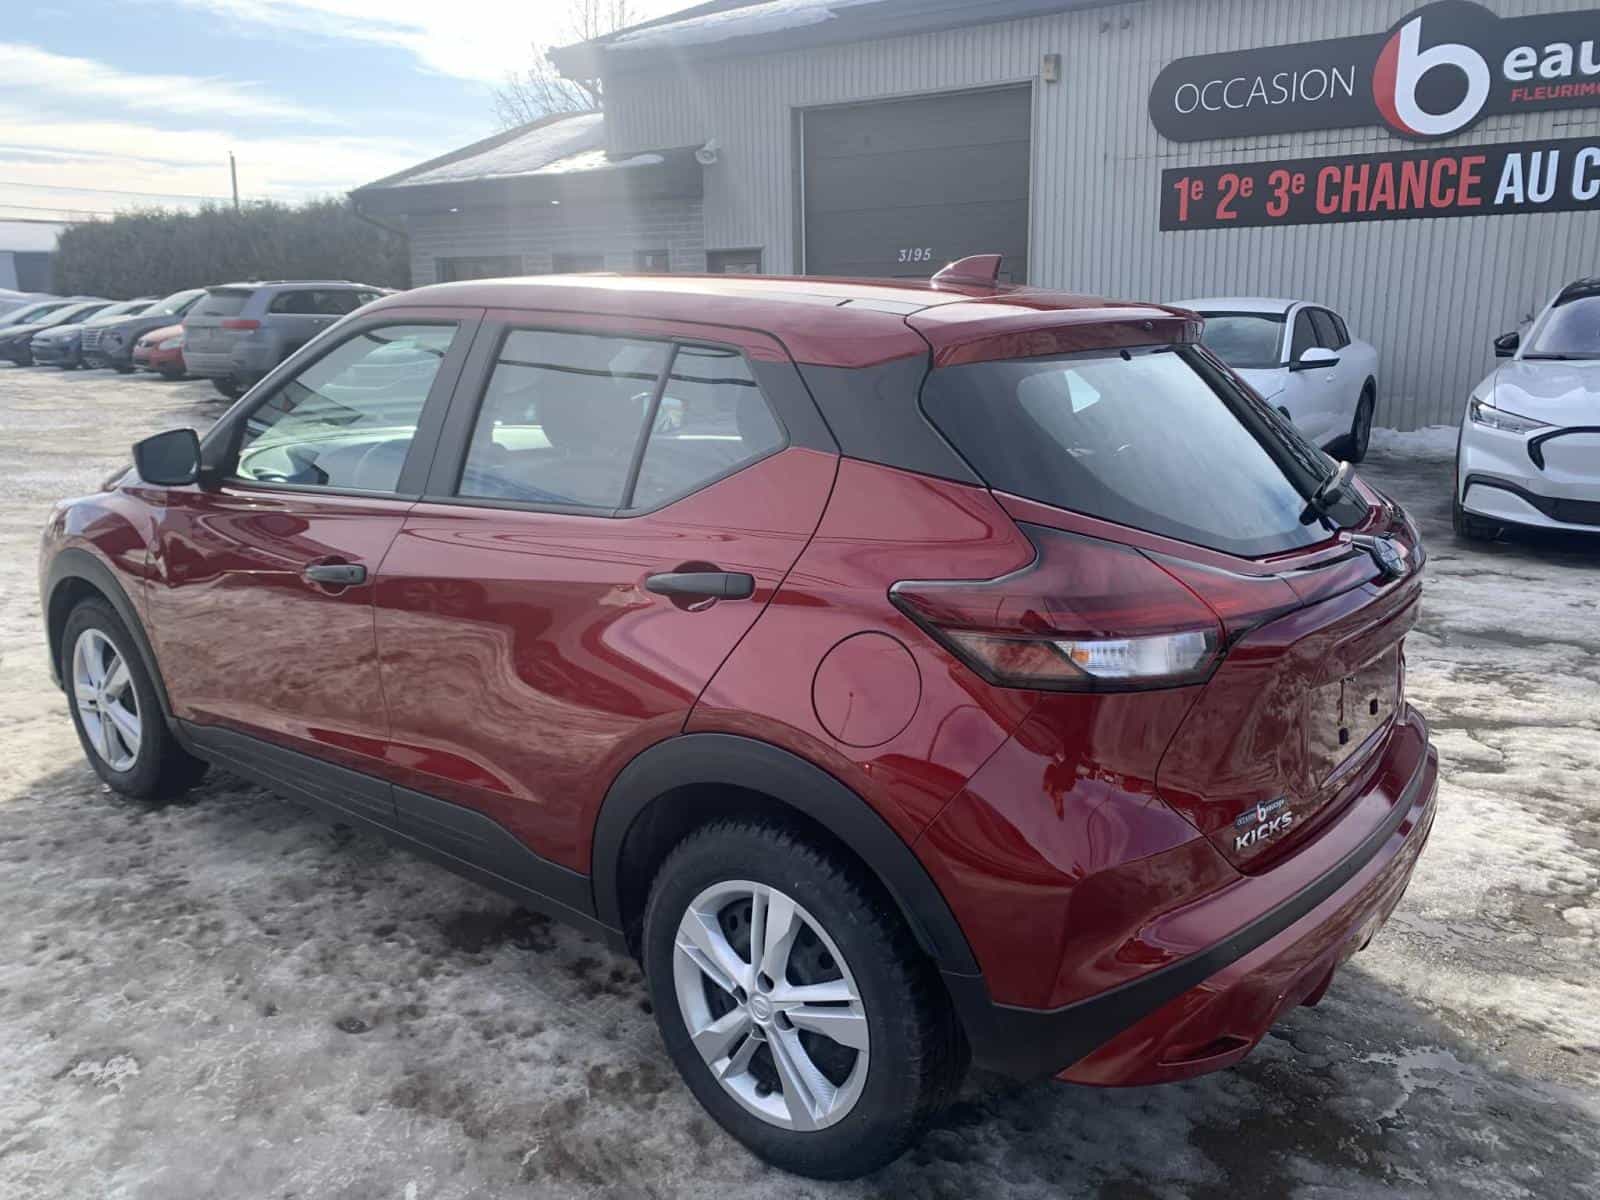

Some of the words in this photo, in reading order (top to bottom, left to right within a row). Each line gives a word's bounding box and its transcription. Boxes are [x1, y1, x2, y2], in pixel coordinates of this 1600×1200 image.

[1174, 65, 1355, 114] OCCASION
[1511, 82, 1600, 102] FLEURIM
[1174, 176, 1205, 222] 1e
[1215, 173, 1254, 220] 2e
[1266, 169, 1306, 218] 3e
[1316, 155, 1487, 215] CHANCE
[1494, 150, 1560, 205] AU
[898, 247, 932, 262] 3195
[1235, 811, 1293, 850] KICKS
